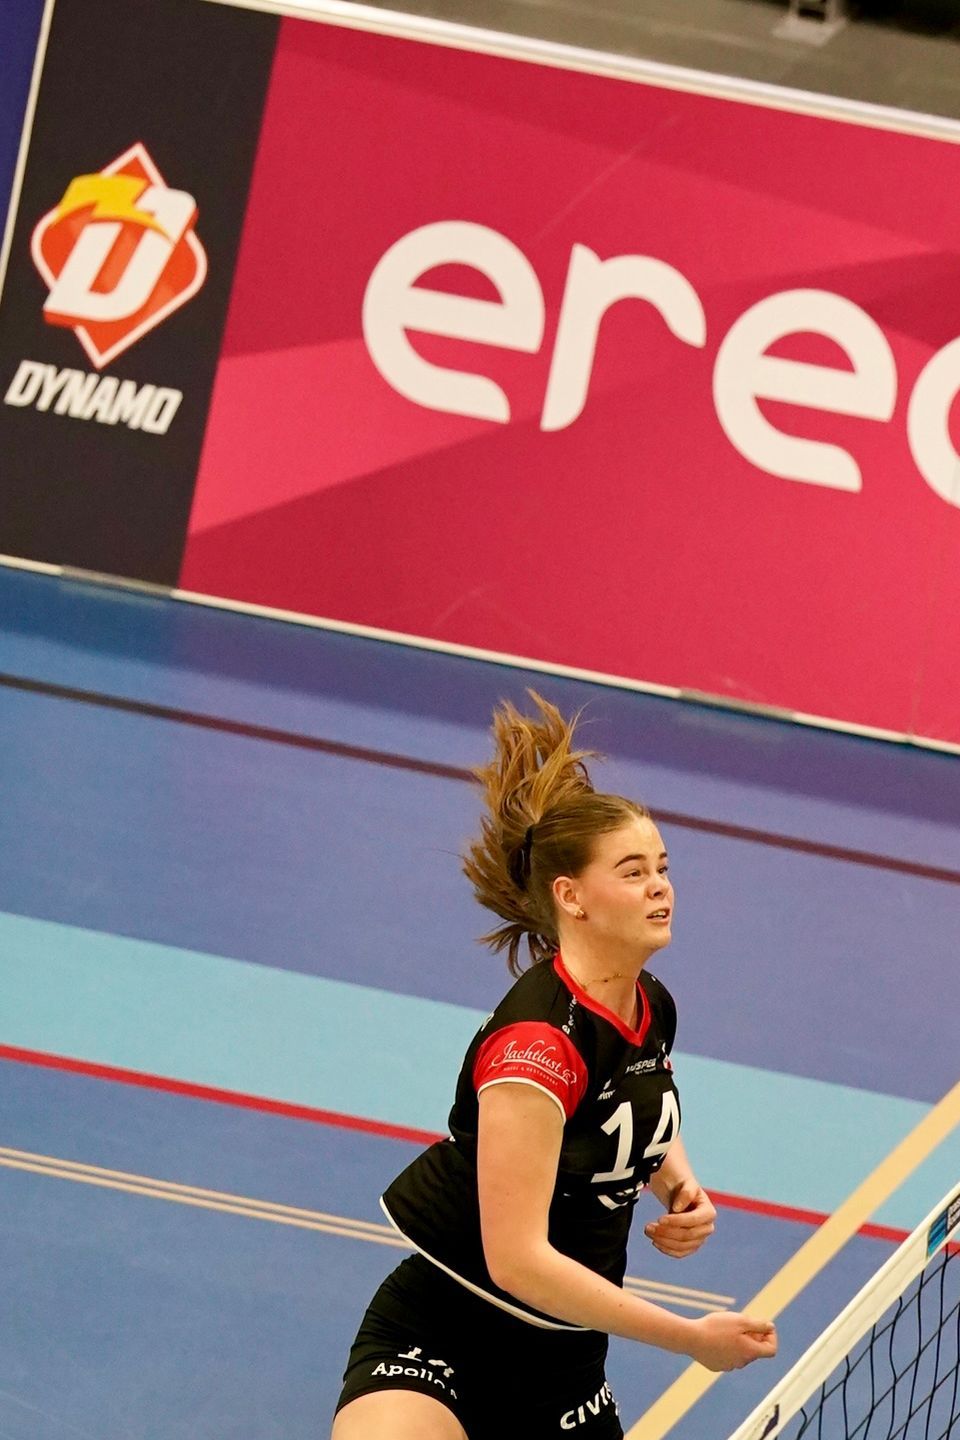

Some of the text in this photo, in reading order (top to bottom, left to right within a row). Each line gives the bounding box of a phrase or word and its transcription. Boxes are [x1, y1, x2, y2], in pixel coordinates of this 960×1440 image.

[4, 359, 184, 436] DYNAMO
[490, 1039, 562, 1073] Jachtlust
[590, 1089, 682, 1185] 14
